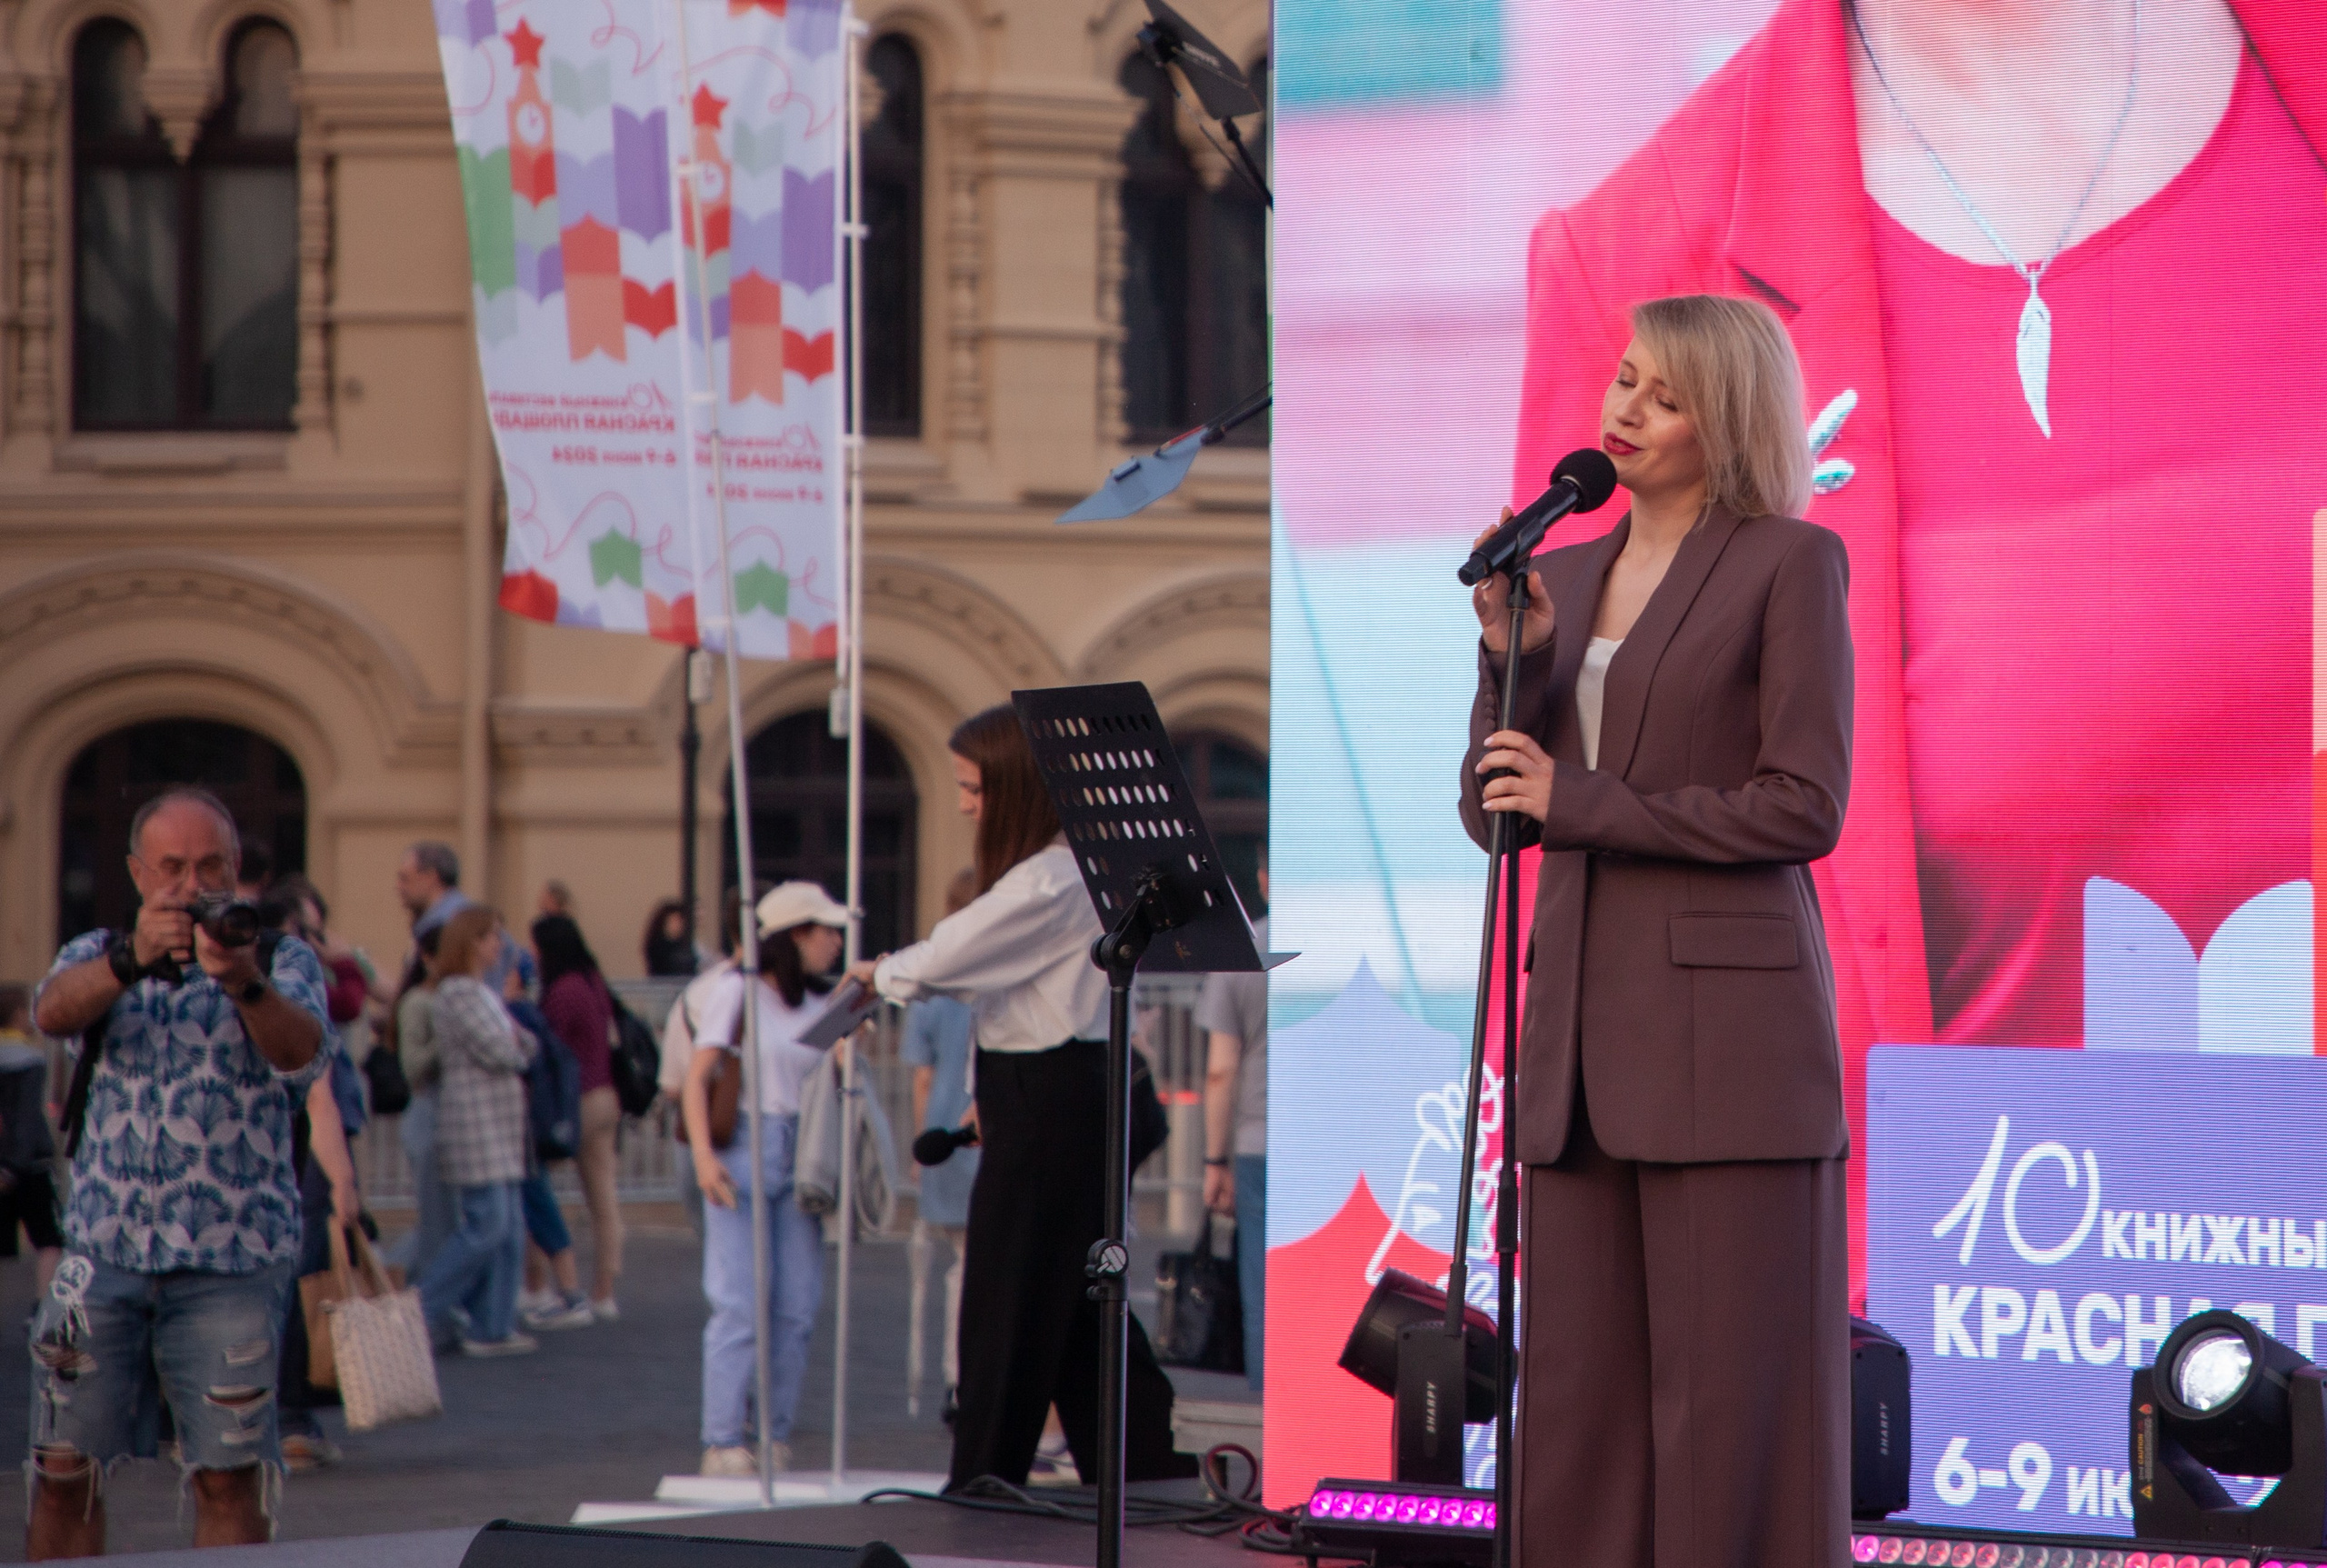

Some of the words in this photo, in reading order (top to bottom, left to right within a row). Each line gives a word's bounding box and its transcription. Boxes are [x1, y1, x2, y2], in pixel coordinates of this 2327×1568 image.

[1933, 1114, 2101, 1265] 10
[1933, 1283, 2276, 1367] КРАСН
[1425, 1380, 1436, 1434] SHARPY
[1879, 1402, 1889, 1456] SHARPY
